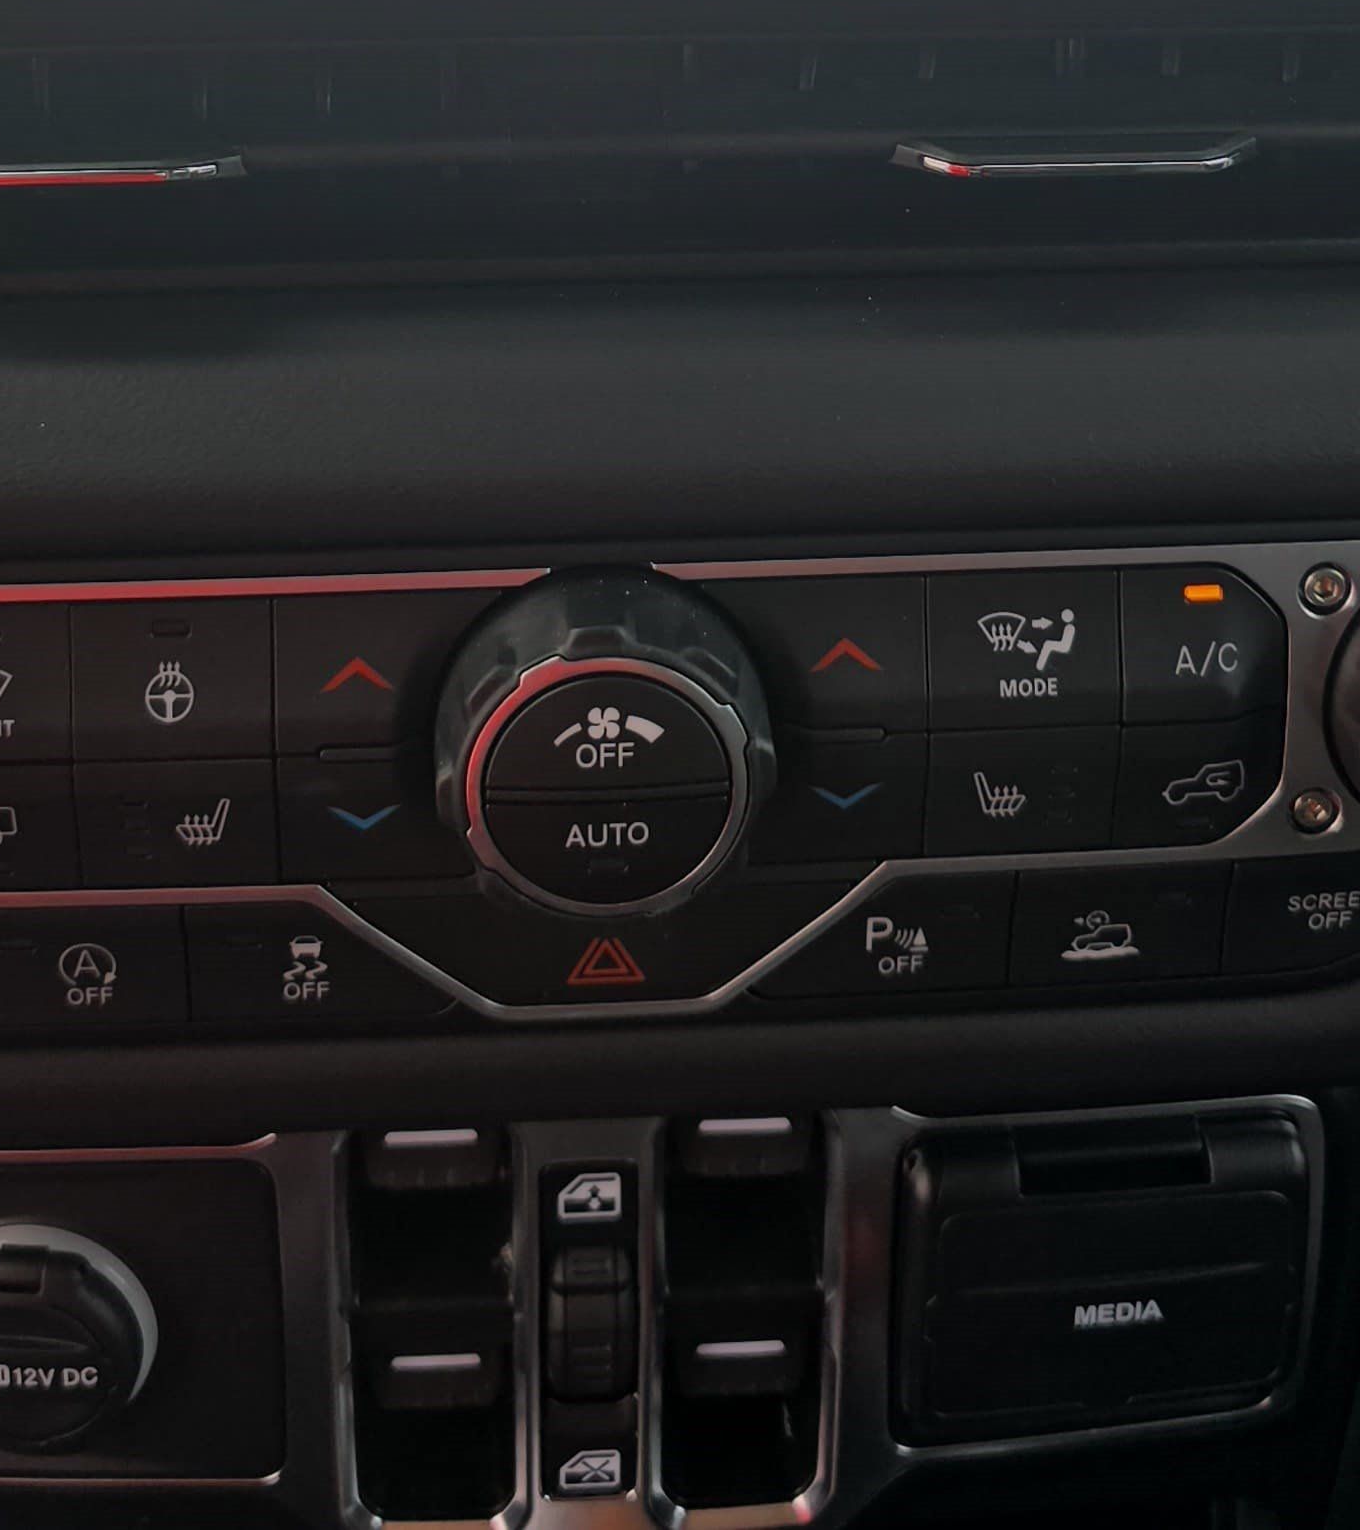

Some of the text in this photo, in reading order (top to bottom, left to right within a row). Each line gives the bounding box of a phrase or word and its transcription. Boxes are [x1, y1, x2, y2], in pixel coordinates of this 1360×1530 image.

[1175, 640, 1239, 677] A/C
[999, 677, 1059, 699] MODE
[575, 741, 635, 769] OFF
[564, 820, 650, 850] AUTO
[1308, 910, 1354, 930] OFF
[865, 916, 894, 953] P
[877, 954, 925, 975] OFF
[67, 985, 114, 1006] OFF
[283, 980, 331, 1001] OFF
[1073, 1298, 1165, 1327] MEDIA
[12, 1366, 99, 1389] 12V DC
